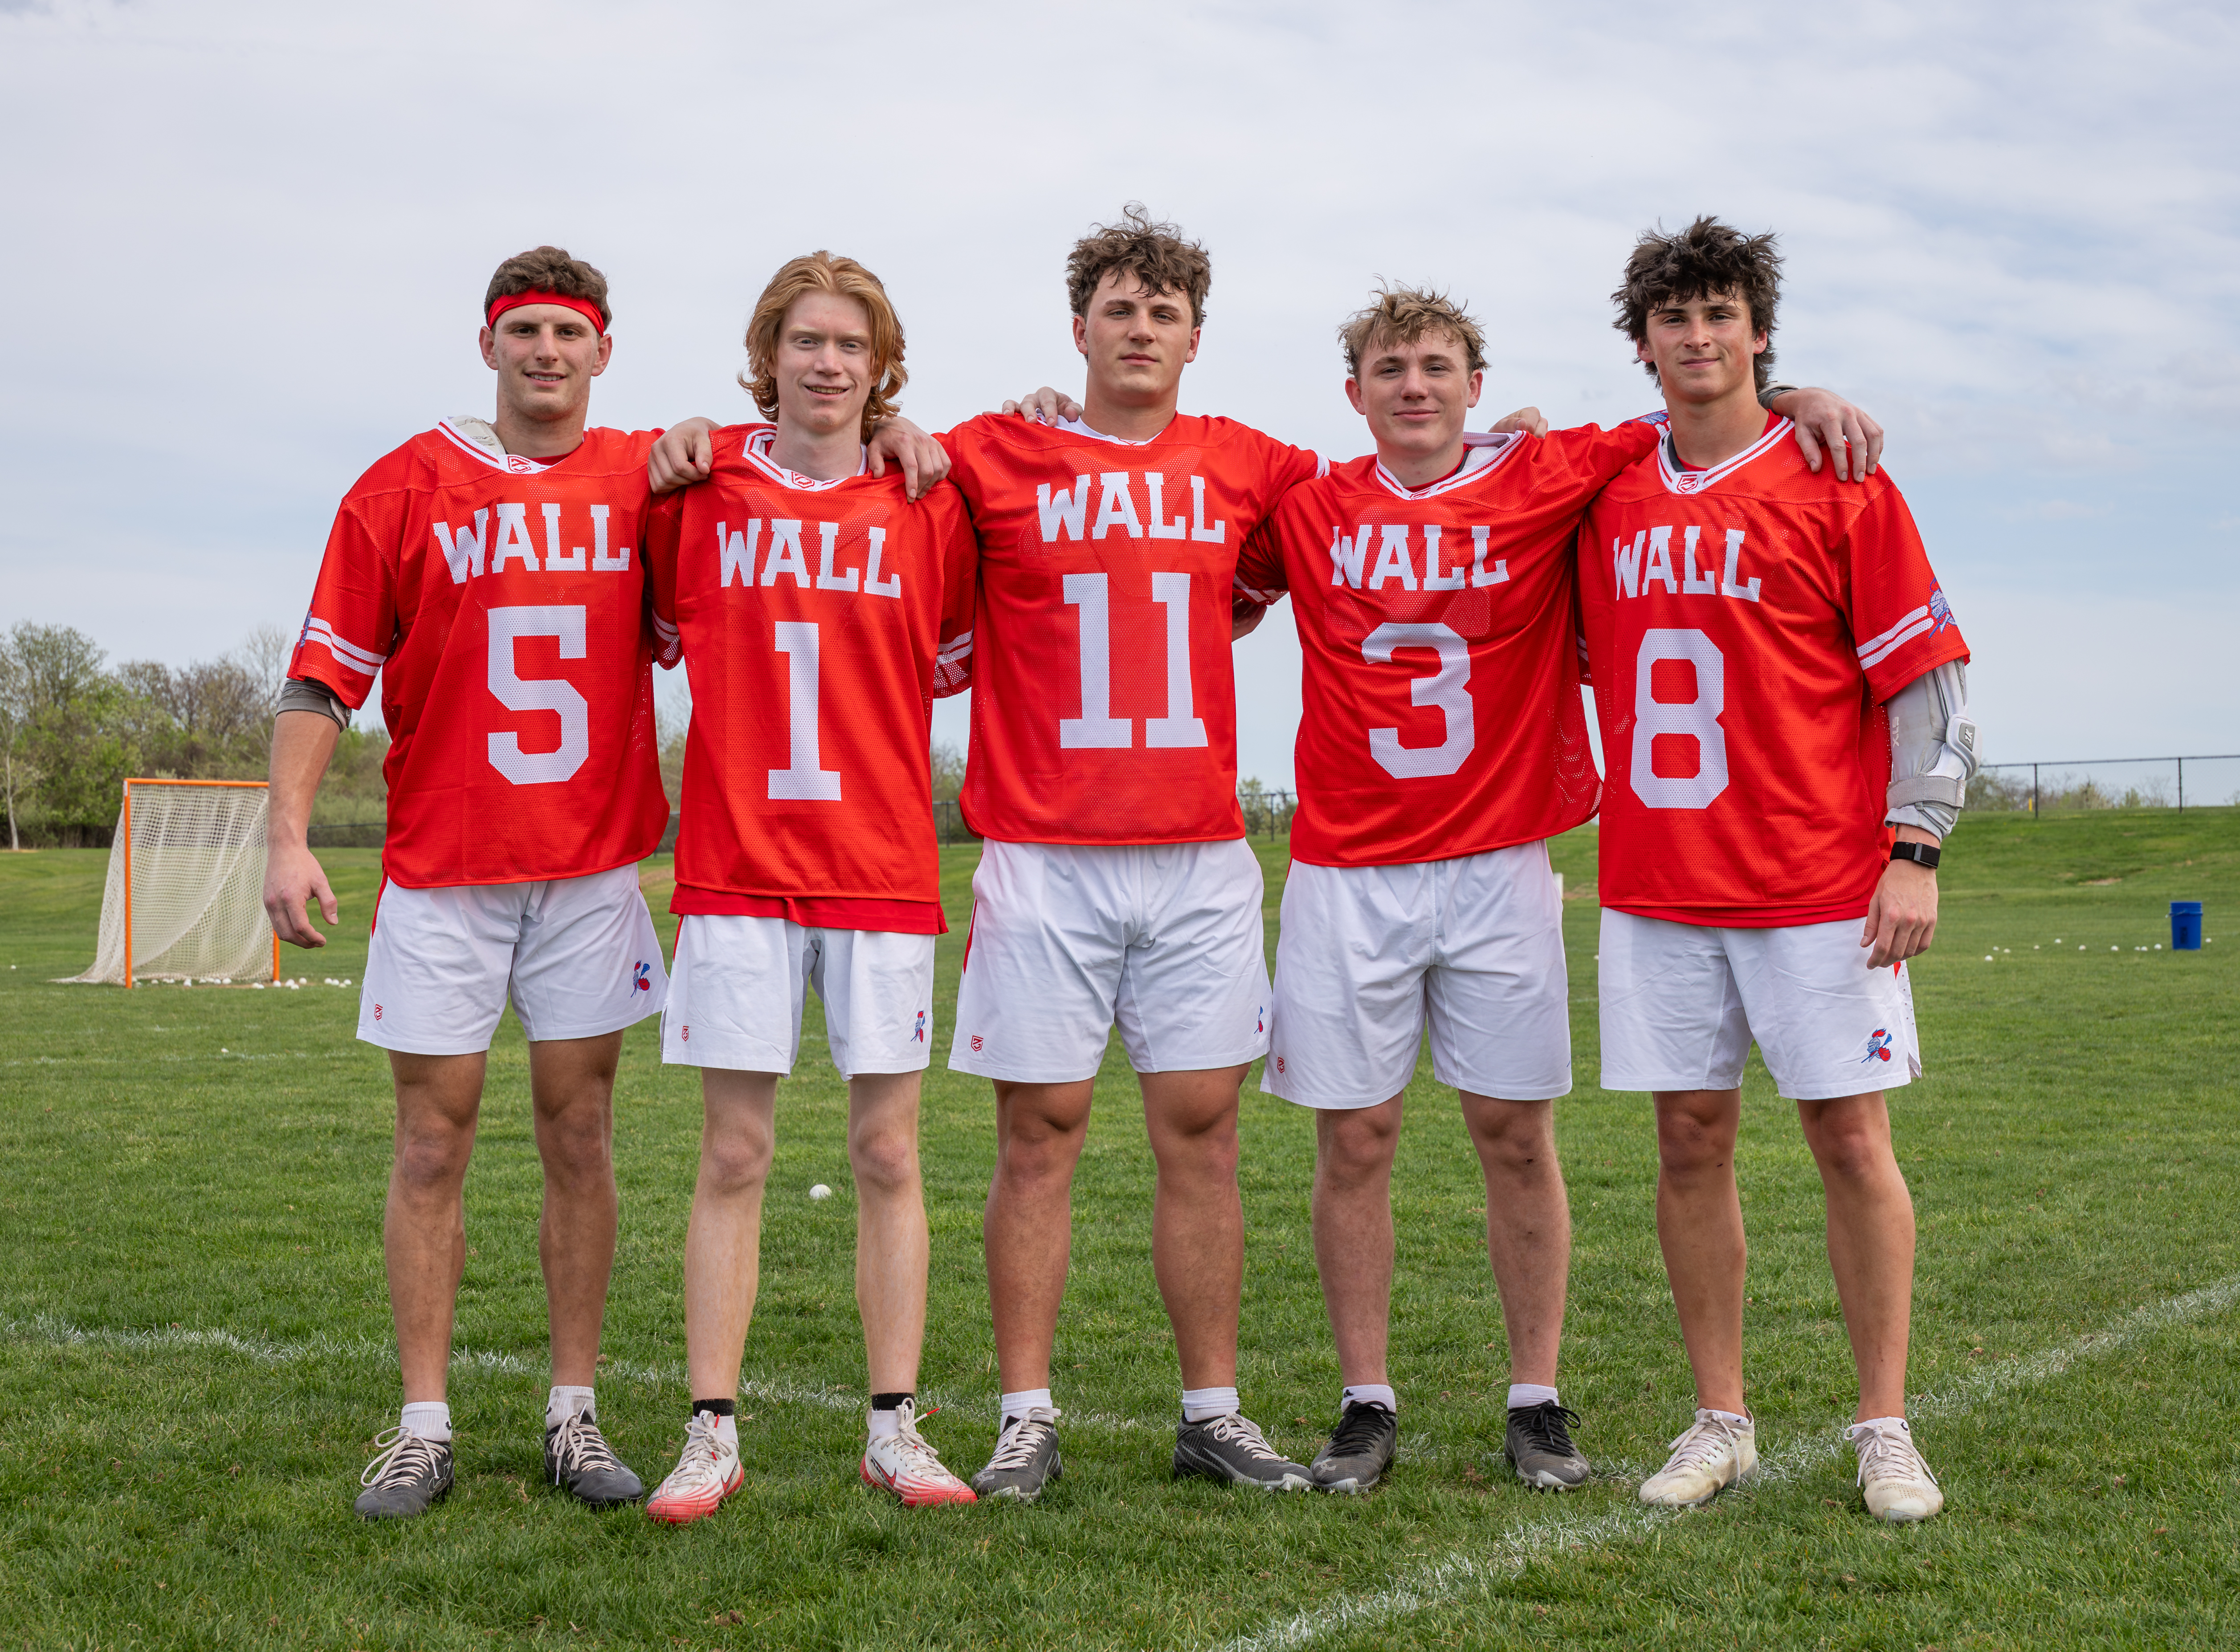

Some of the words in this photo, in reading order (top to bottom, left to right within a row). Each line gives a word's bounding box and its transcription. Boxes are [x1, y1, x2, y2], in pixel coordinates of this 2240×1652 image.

[433, 503, 630, 584] WALL
[1036, 472, 1225, 544] WALL
[717, 519, 901, 598] WALL
[1331, 524, 1510, 591] WALL
[1614, 526, 1761, 602] WALL
[488, 605, 589, 785] 5
[1060, 572, 1208, 749] 11
[1361, 623, 1475, 779] 3
[767, 621, 841, 801] 1
[1630, 628, 1729, 809] 8
[1892, 716, 1900, 749] STX
